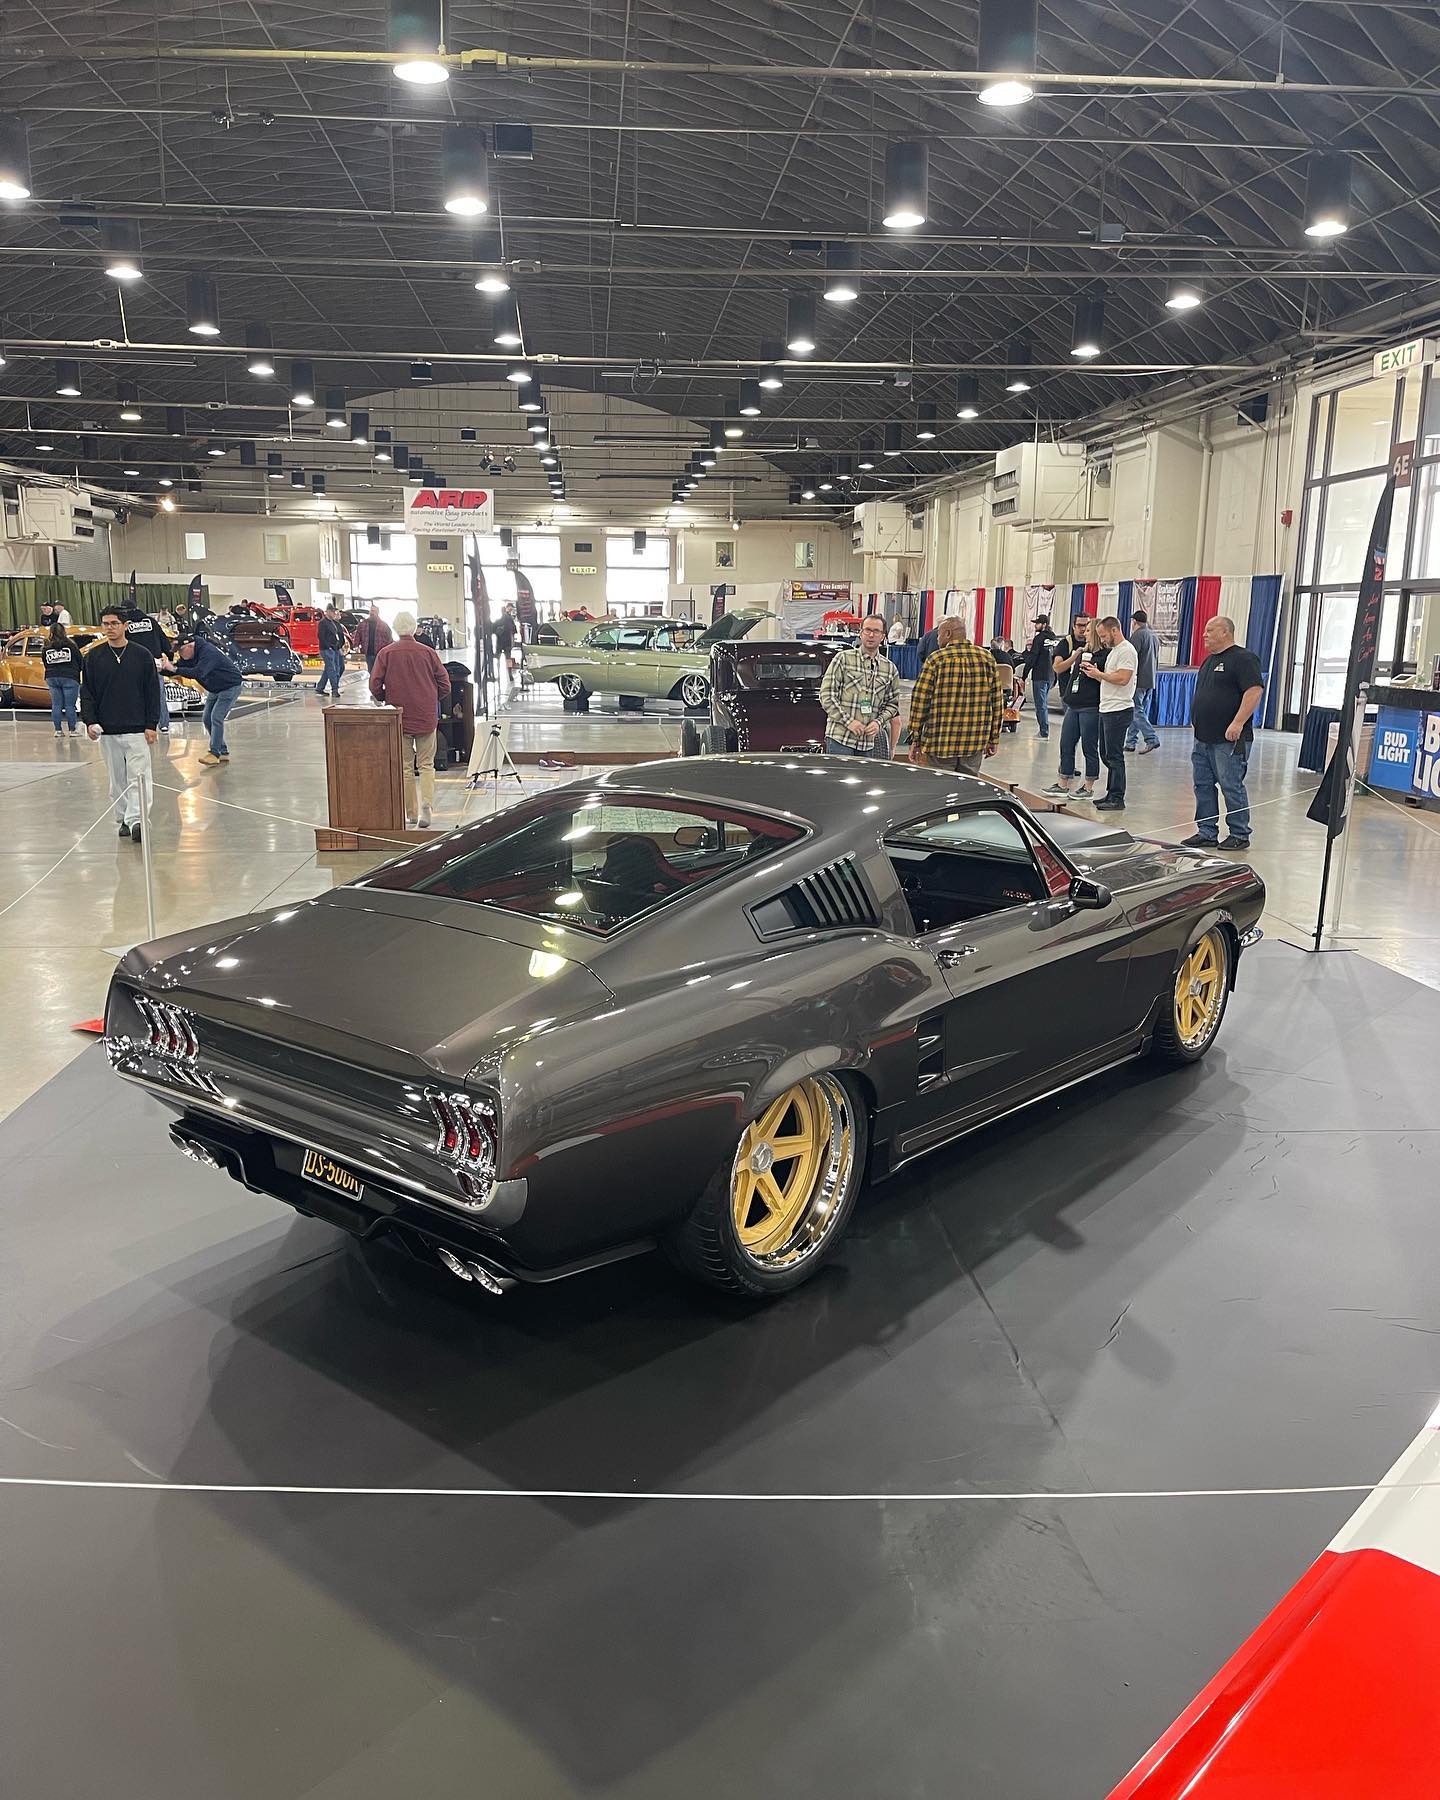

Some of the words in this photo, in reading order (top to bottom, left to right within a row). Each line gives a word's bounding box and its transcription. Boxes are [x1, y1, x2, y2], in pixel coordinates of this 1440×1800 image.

[1380, 344, 1416, 371] EXIT
[1393, 454, 1410, 477] 6E
[411, 490, 488, 509] ARP
[1383, 731, 1408, 748] BUD
[1377, 745, 1411, 764] LIGHT
